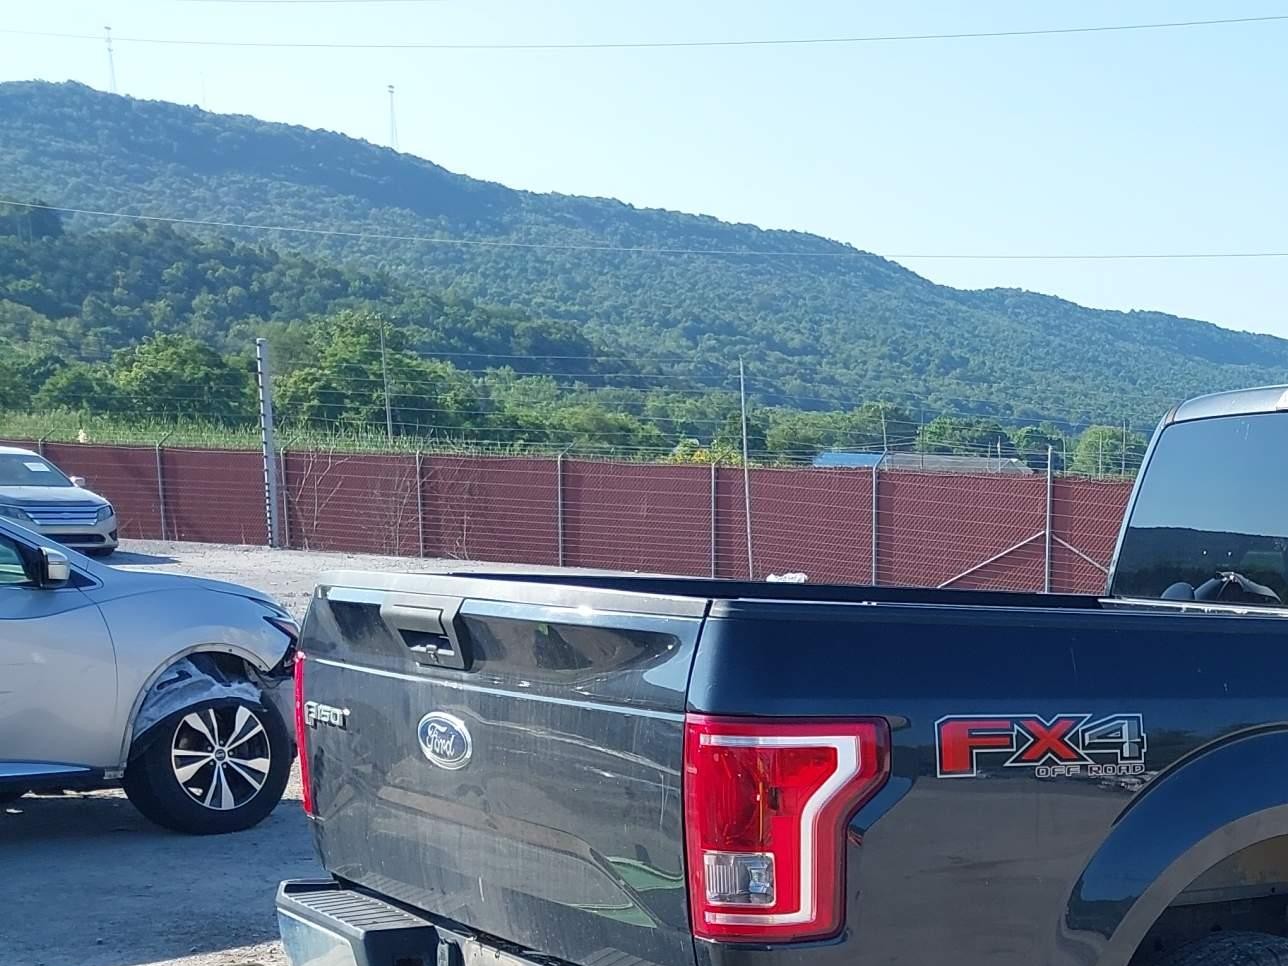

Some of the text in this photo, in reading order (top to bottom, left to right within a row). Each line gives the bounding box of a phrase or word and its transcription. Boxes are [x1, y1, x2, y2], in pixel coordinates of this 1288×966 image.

[426, 722, 455, 756] Ford
[935, 713, 1147, 778] FX4
[1035, 764, 1146, 777] OFF ROAD
